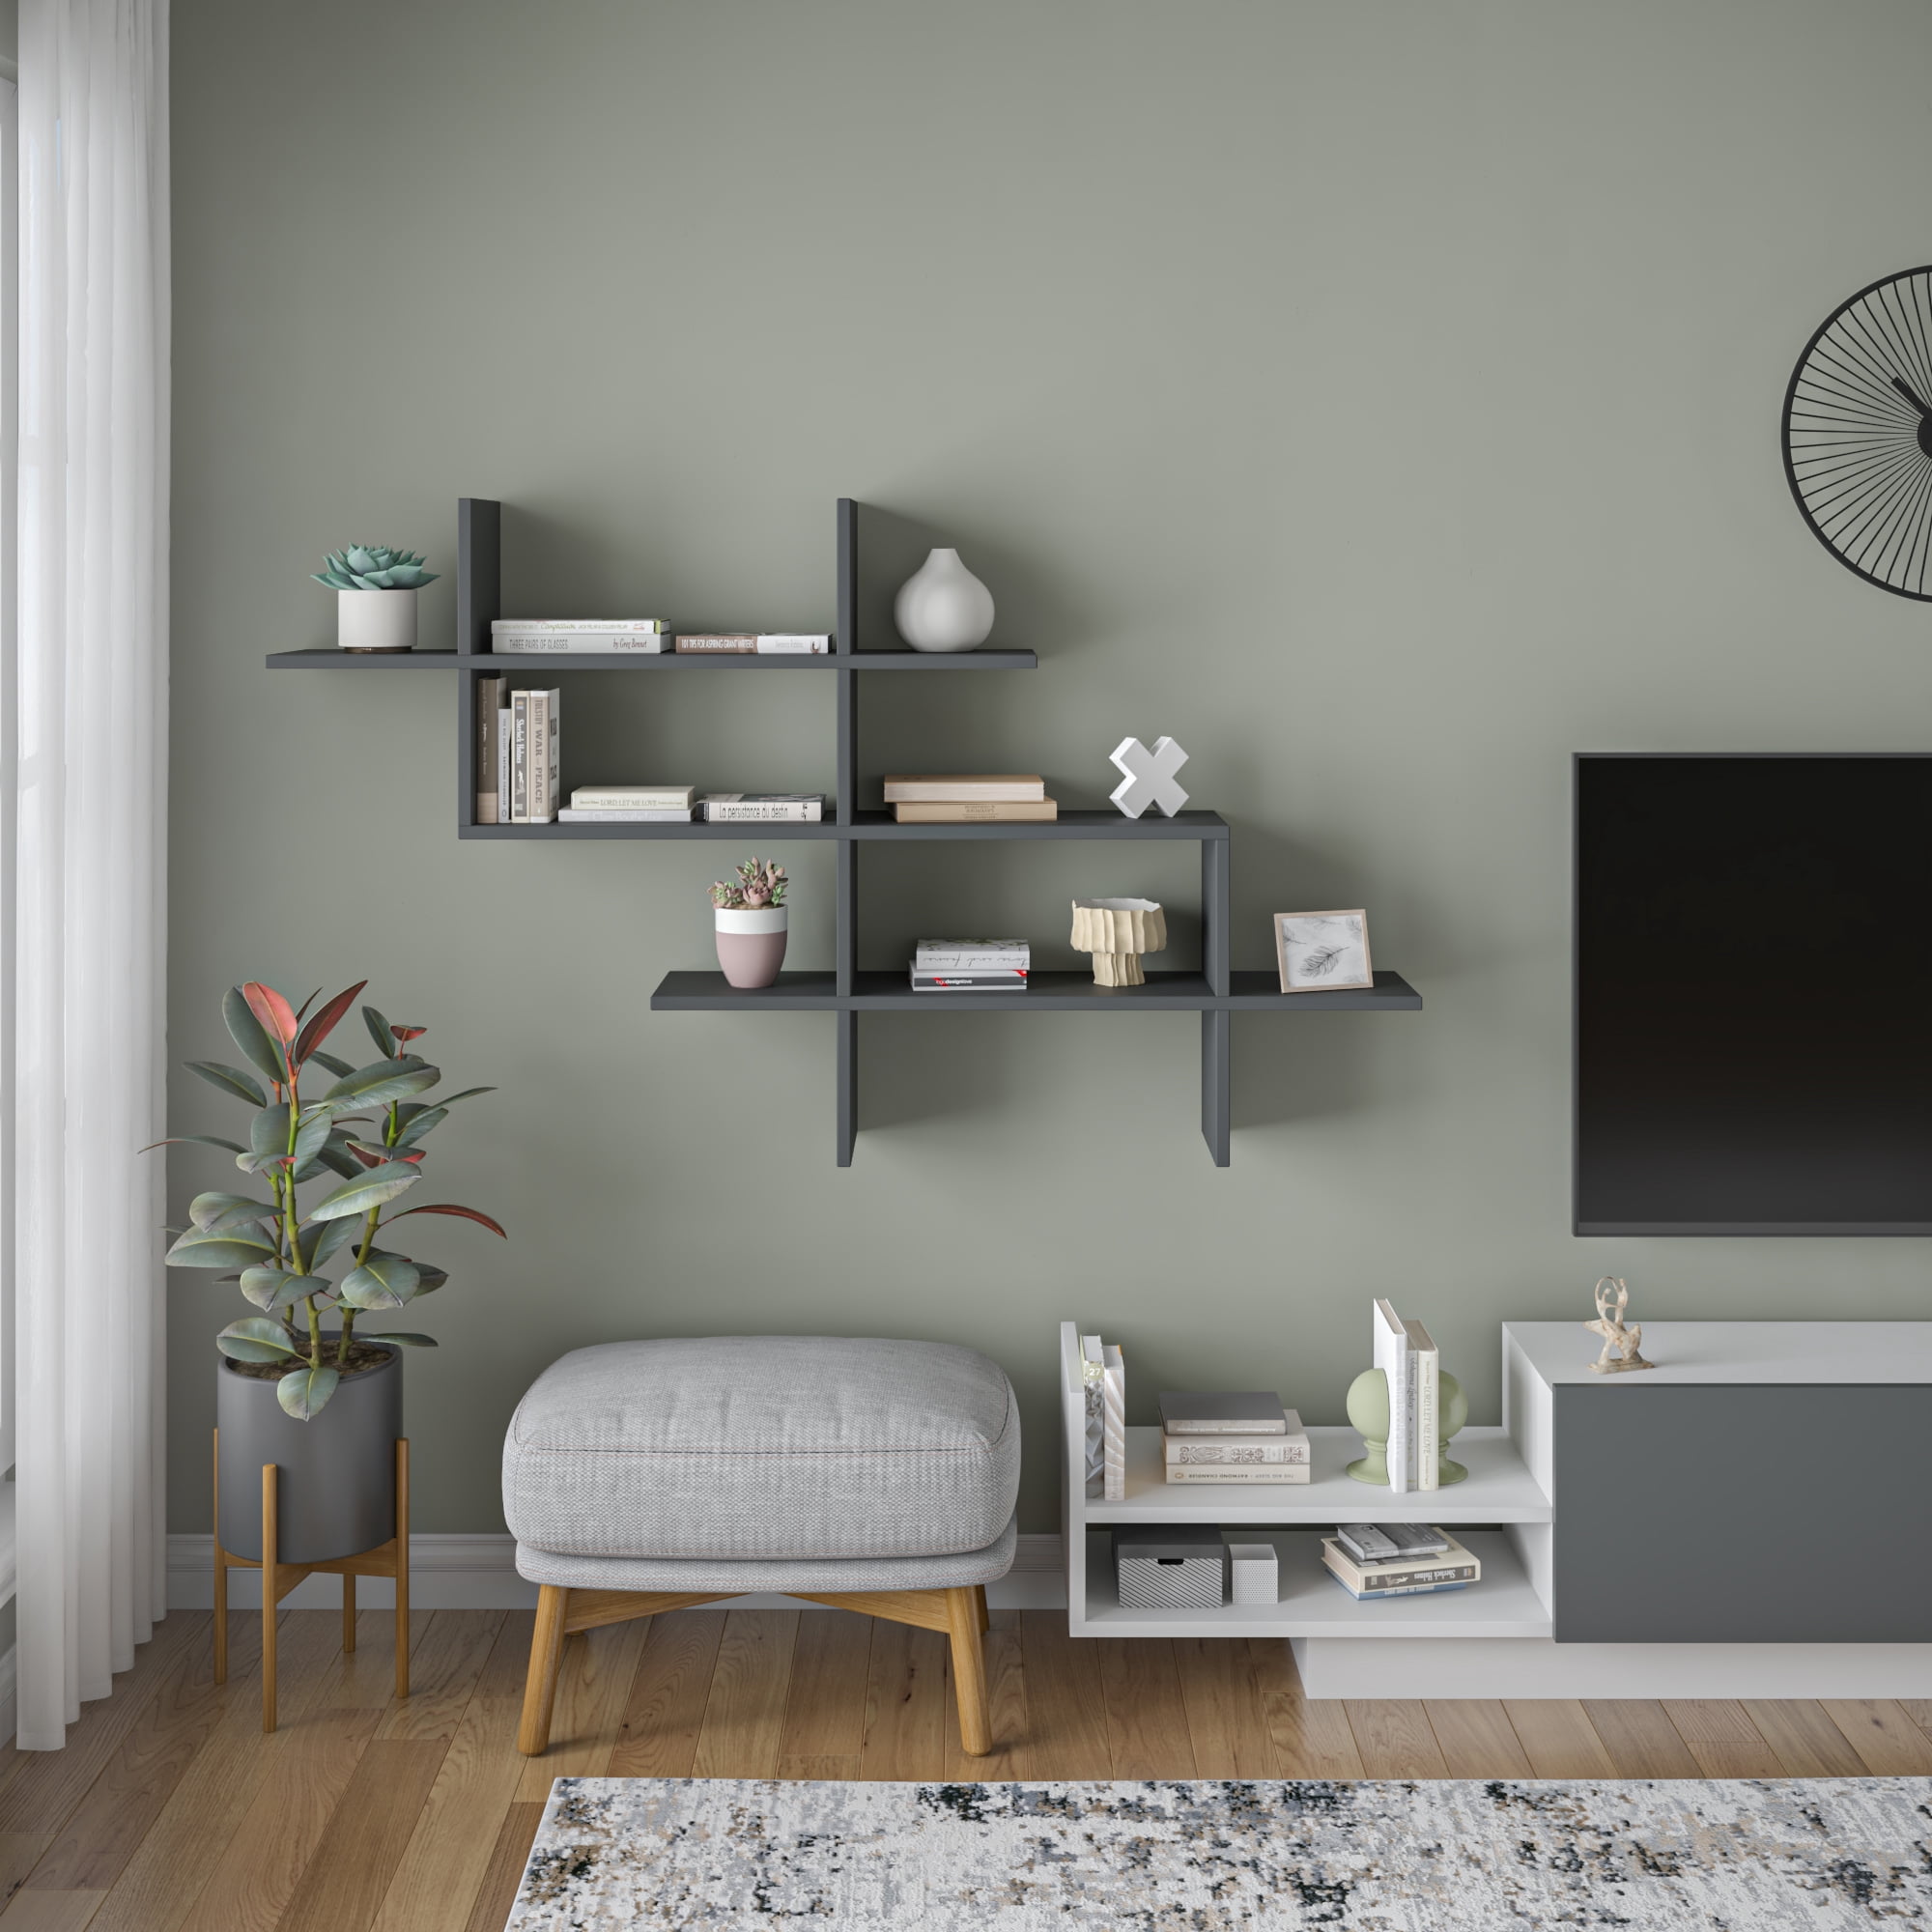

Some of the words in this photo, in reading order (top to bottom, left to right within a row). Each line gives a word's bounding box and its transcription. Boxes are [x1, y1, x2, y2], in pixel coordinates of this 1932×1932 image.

[509, 639, 524, 650] THREE
[526, 639, 539, 650] PAIRS
[540, 639, 547, 650] OF
[548, 639, 569, 650] GLASSES
[534, 699, 543, 725] TOLSTOY
[516, 718, 526, 743] Sherlock
[516, 744, 526, 764] Holmes
[720, 803, 726, 818] La
[771, 803, 788, 818] destin
[1089, 1368, 1101, 1377] 27
[1413, 1572, 1434, 1582] Holmes
[1434, 1569, 1456, 1581] Sherlock
